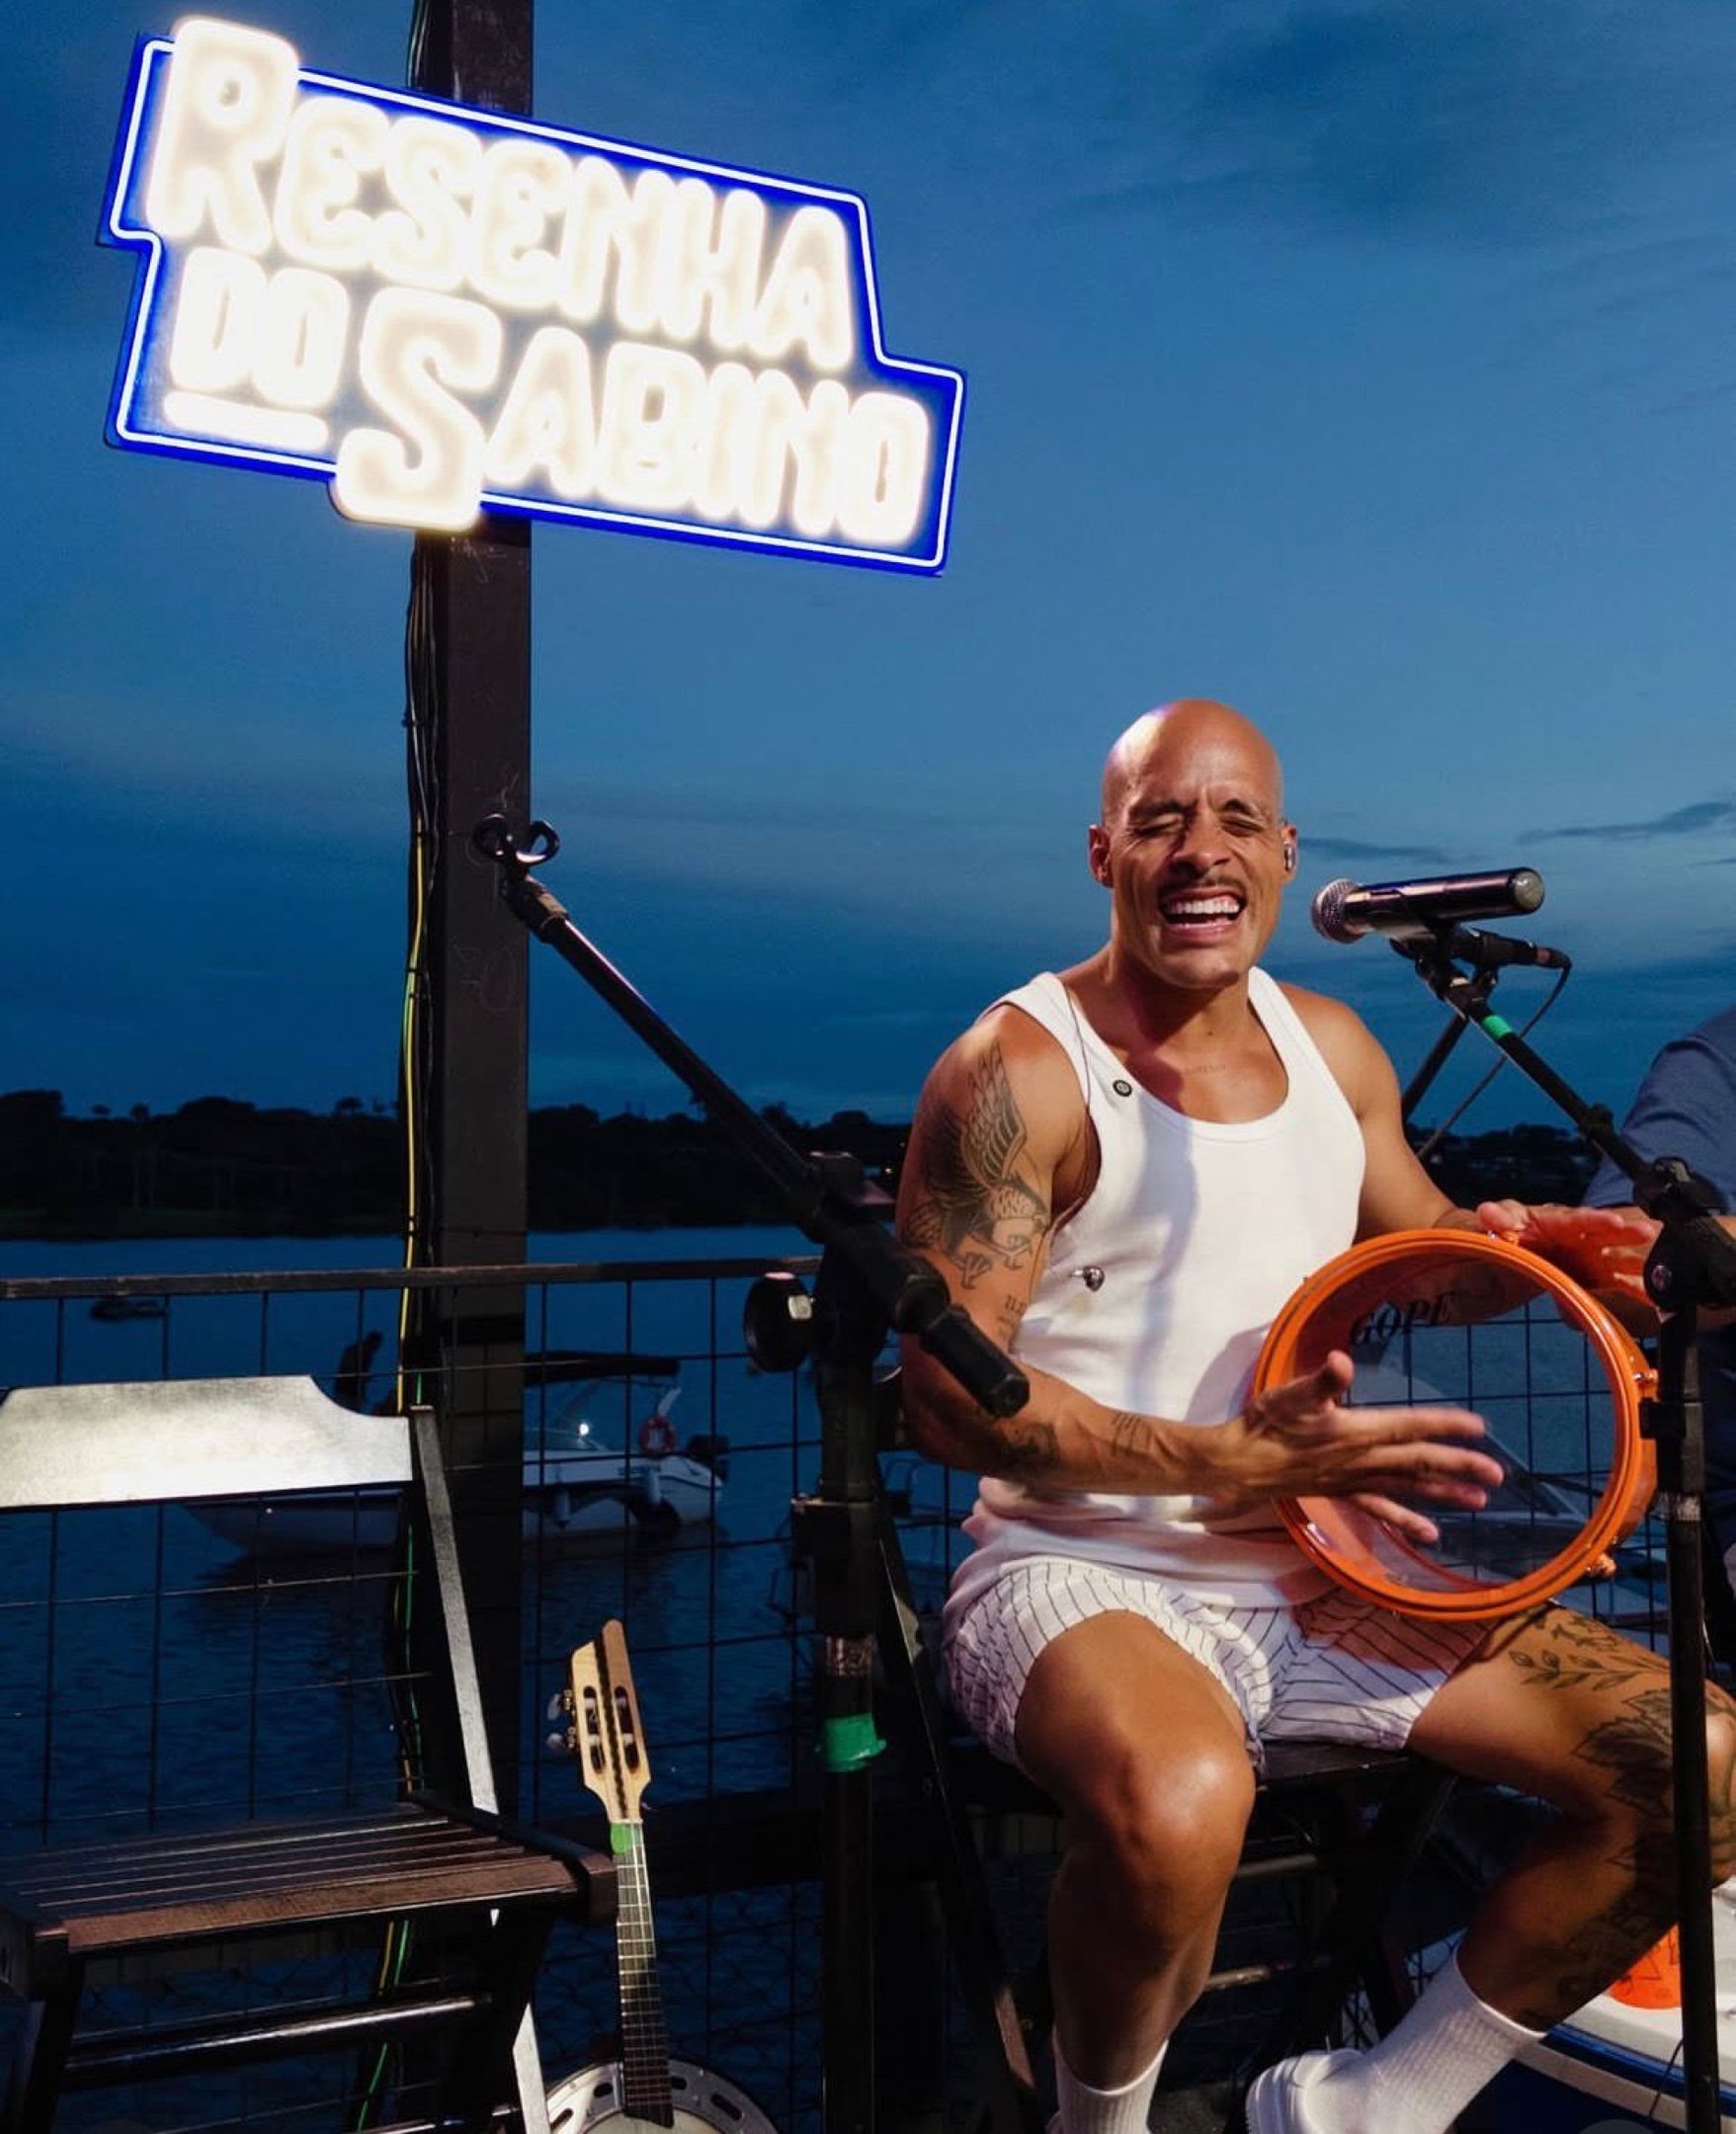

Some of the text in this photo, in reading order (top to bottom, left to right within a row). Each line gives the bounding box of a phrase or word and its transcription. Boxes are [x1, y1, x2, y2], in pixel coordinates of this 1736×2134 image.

[146, 17, 854, 371] RESENHA
[170, 246, 930, 544] DO SABINO
